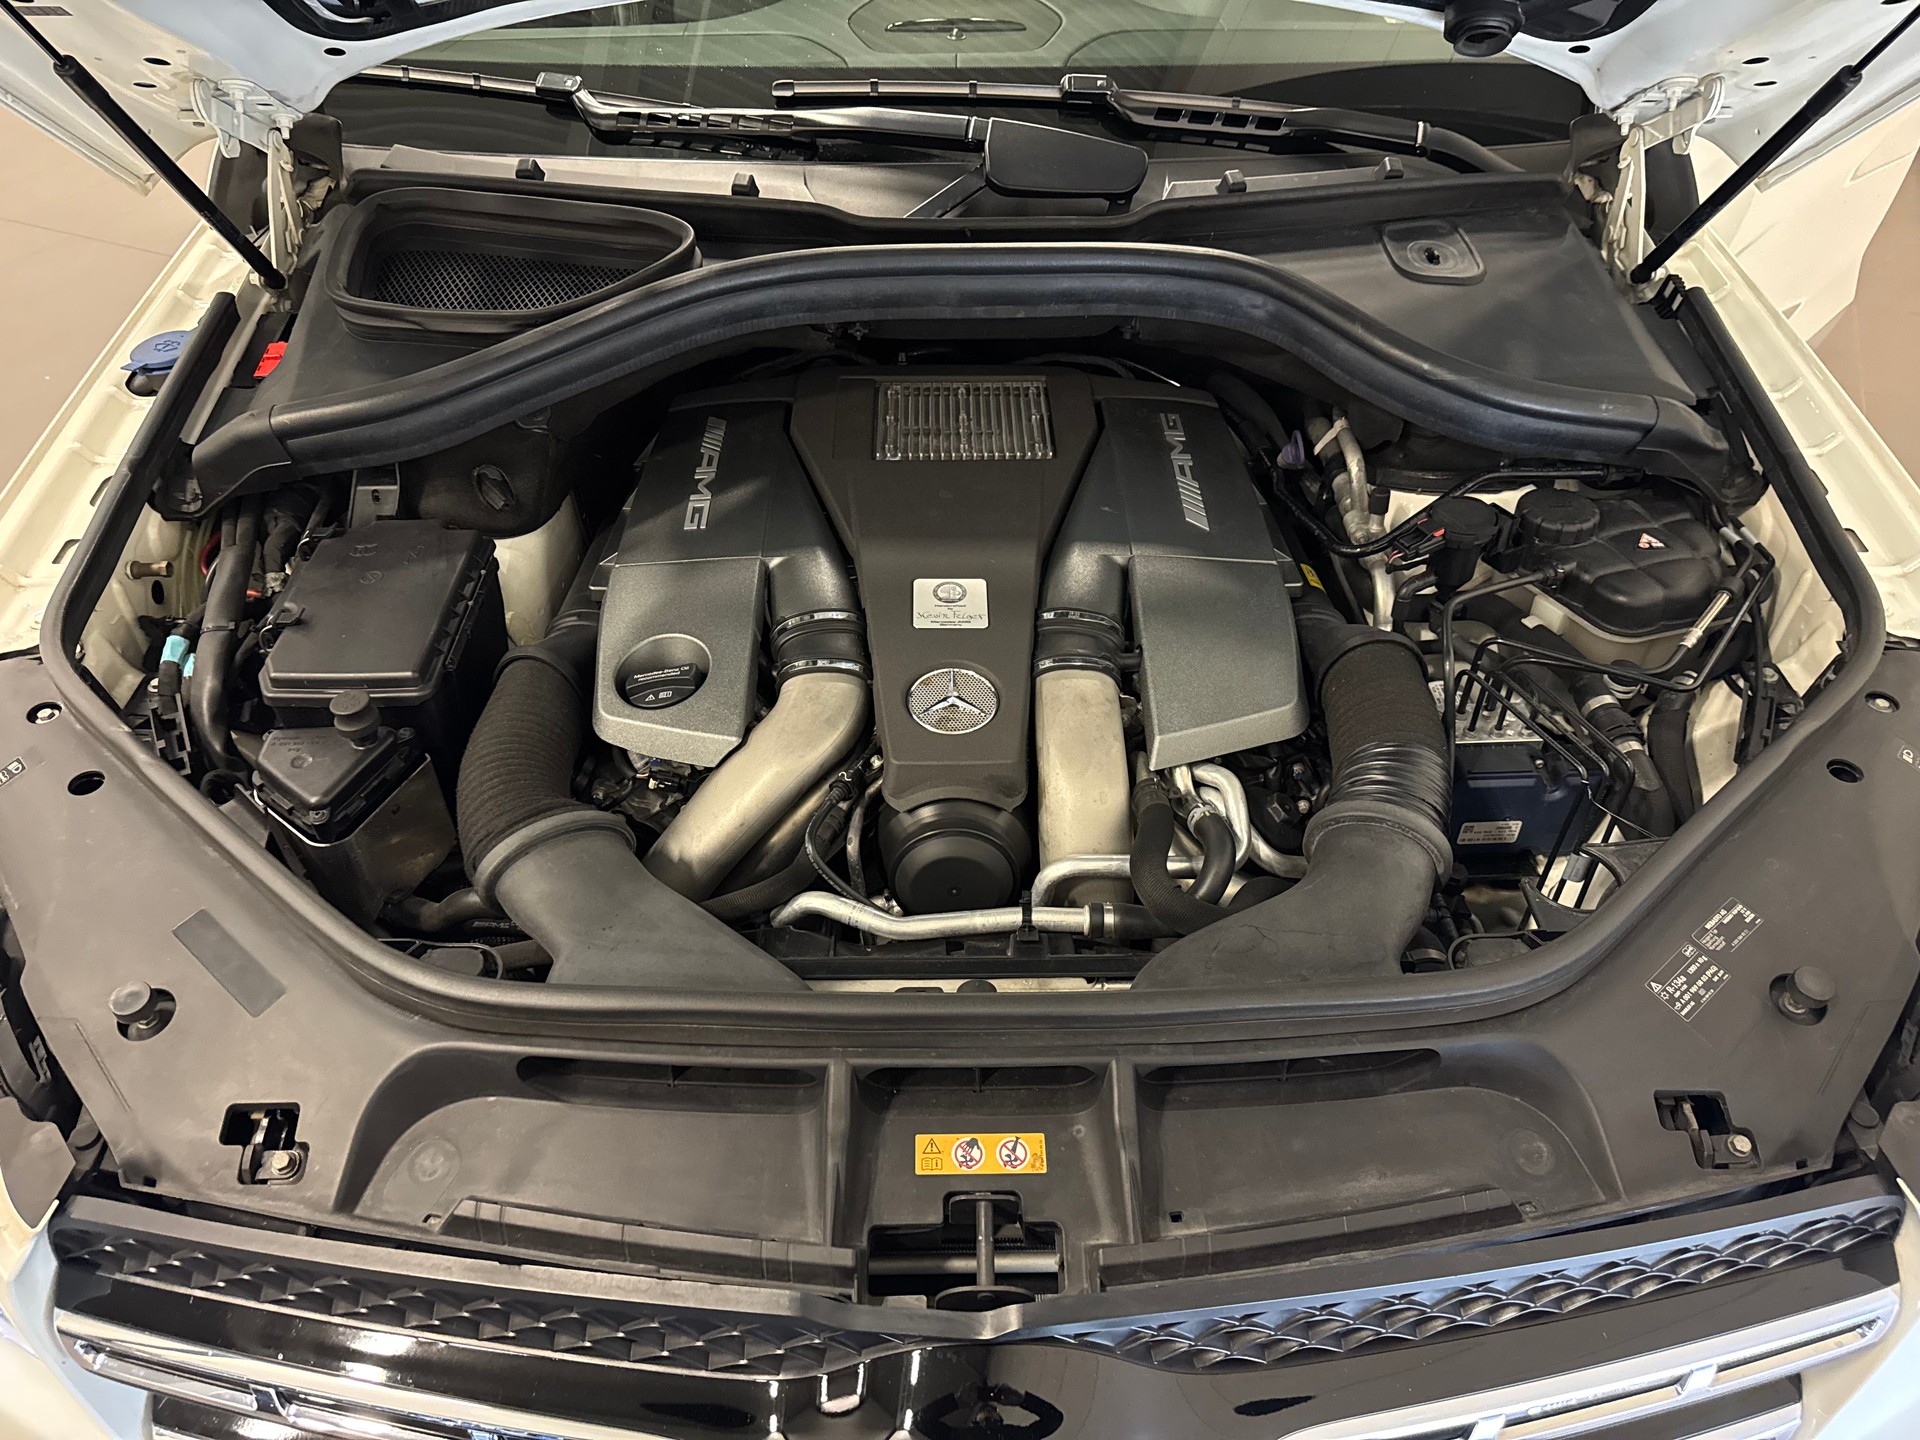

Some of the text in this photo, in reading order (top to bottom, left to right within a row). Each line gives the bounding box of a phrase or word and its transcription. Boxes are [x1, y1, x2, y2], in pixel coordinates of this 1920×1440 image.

[683, 446, 721, 531] AMG
[638, 671, 681, 682] recommended
[1666, 975, 1687, 994] R-134a
[1682, 991, 1692, 1002] 001
